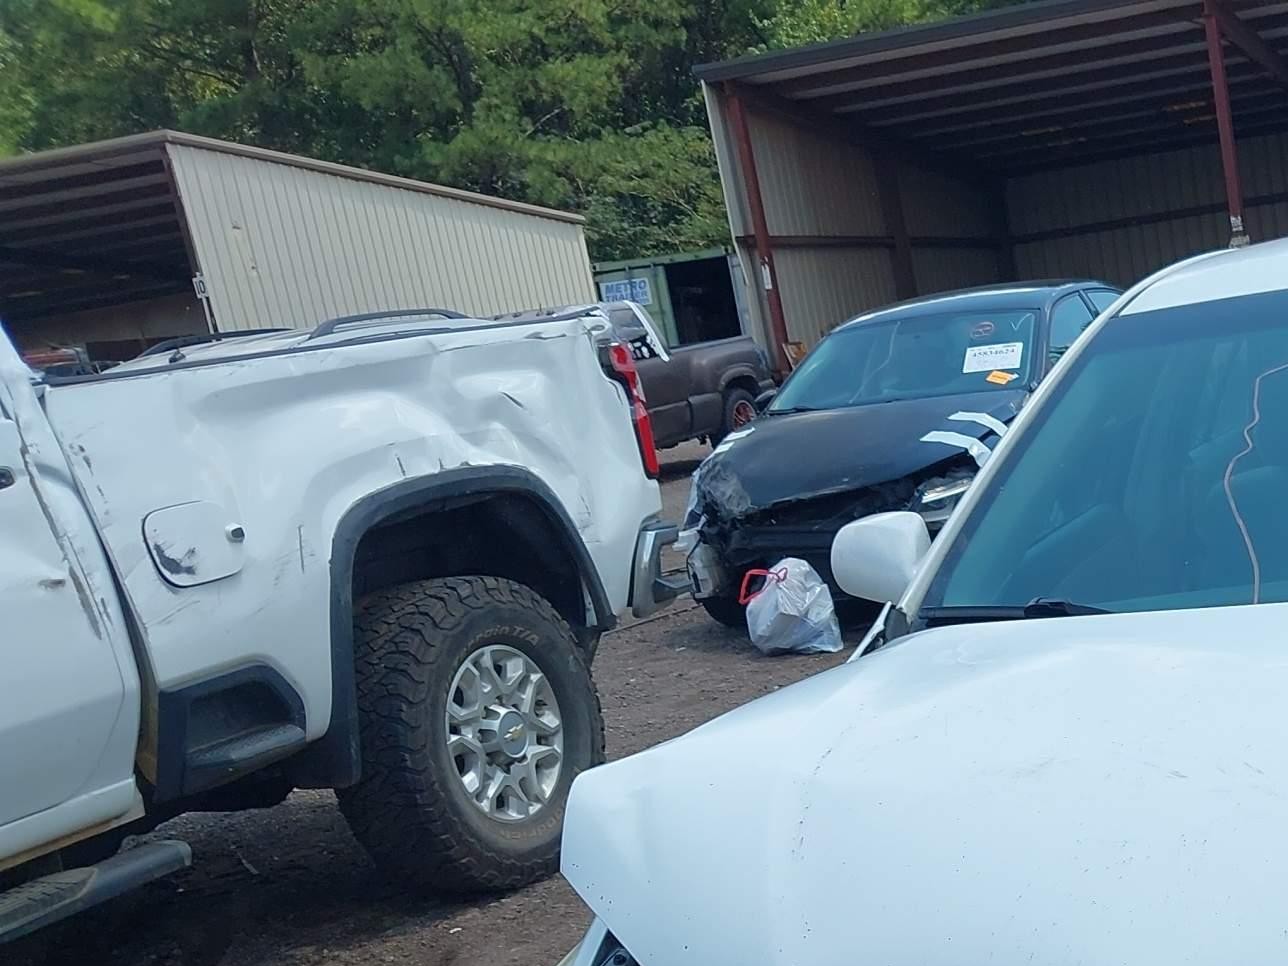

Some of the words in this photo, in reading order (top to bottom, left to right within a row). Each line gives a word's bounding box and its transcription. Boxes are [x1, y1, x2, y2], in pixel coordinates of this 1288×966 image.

[195, 280, 206, 294] 10
[605, 280, 646, 294] METRO
[606, 290, 648, 302] TRAIER
